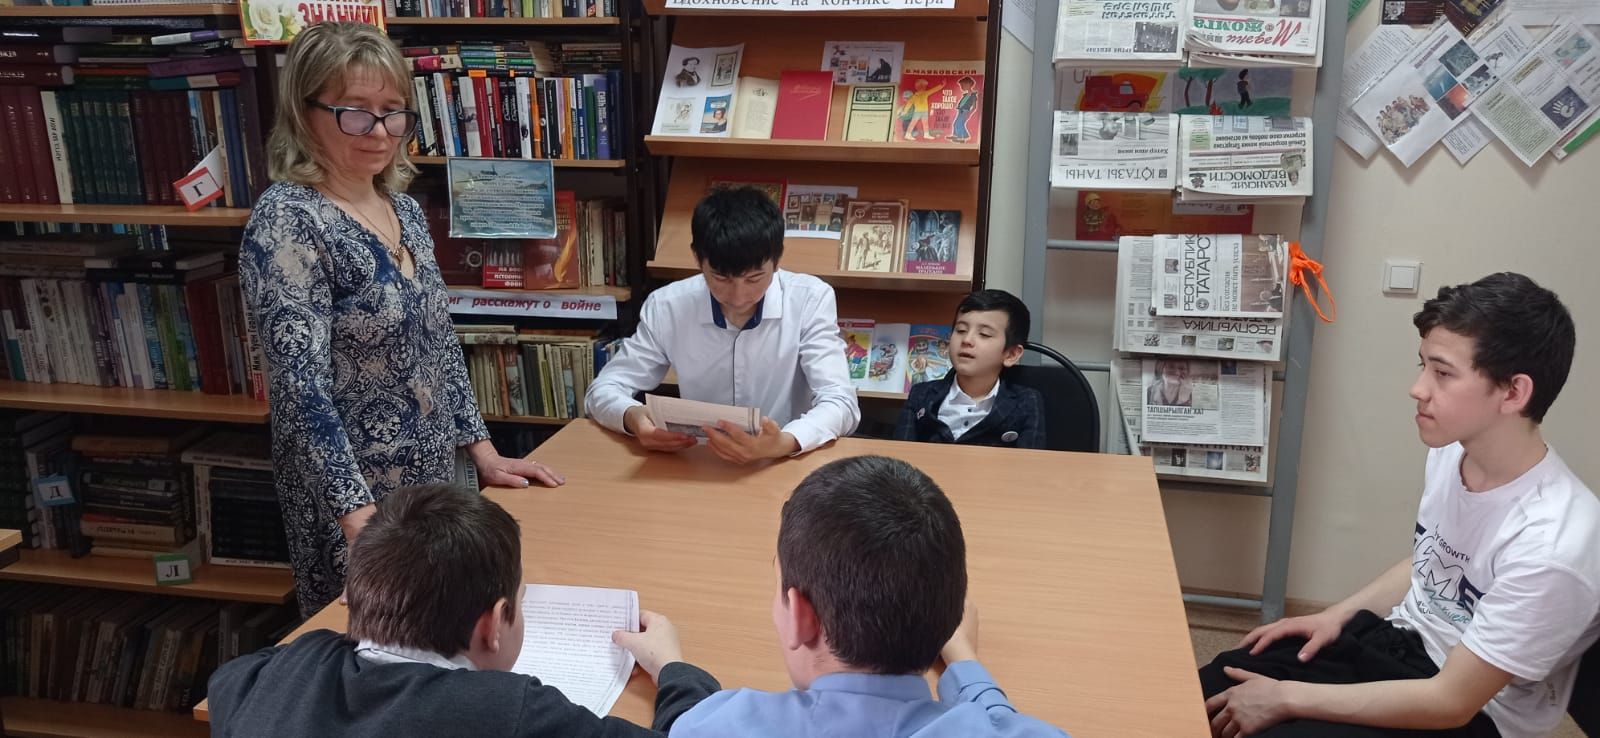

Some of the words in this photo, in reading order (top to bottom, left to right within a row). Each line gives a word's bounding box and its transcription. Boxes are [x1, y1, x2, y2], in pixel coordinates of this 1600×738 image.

[1209, 169, 1287, 182] ВЕДОМОСТИ
[1195, 233, 1211, 298] ТАТАРС
[471, 296, 540, 310] расскажут
[542, 300, 551, 309] о
[561, 299, 602, 311] войне
[1182, 320, 1277, 336] РЕСПУБЛИКА
[1438, 538, 1471, 563] GROWTH
